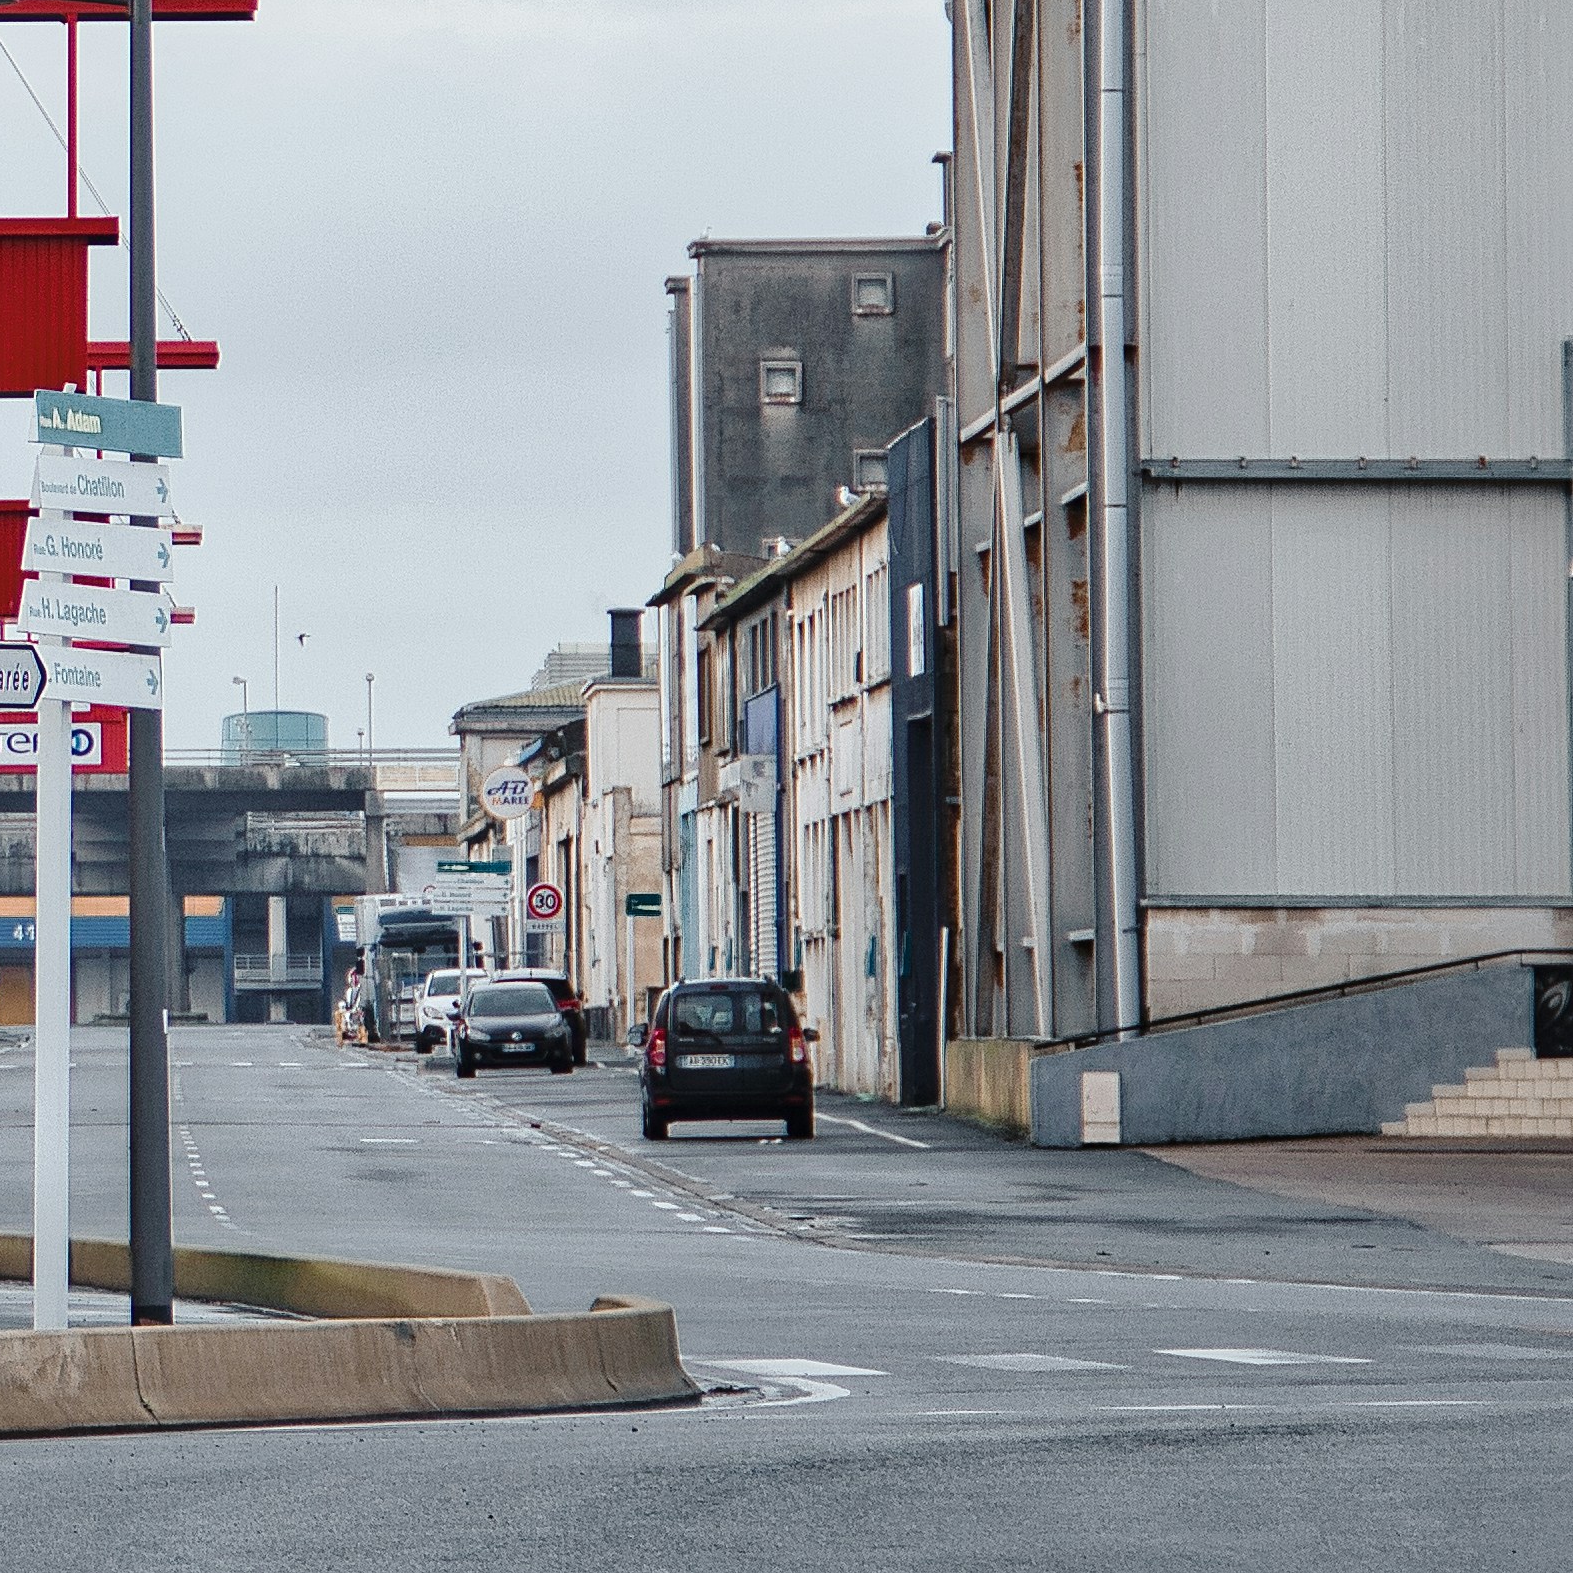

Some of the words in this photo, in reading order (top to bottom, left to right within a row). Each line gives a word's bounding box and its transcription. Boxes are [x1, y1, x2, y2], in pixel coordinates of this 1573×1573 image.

[67, 408, 102, 434] Adam
[46, 534, 59, 557] G.
[61, 536, 103, 561] Honoré
[42, 597, 55, 619] H.
[57, 599, 107, 627] Lagache
[55, 663, 101, 687] Fontaine
[535, 893, 556, 909] 30
